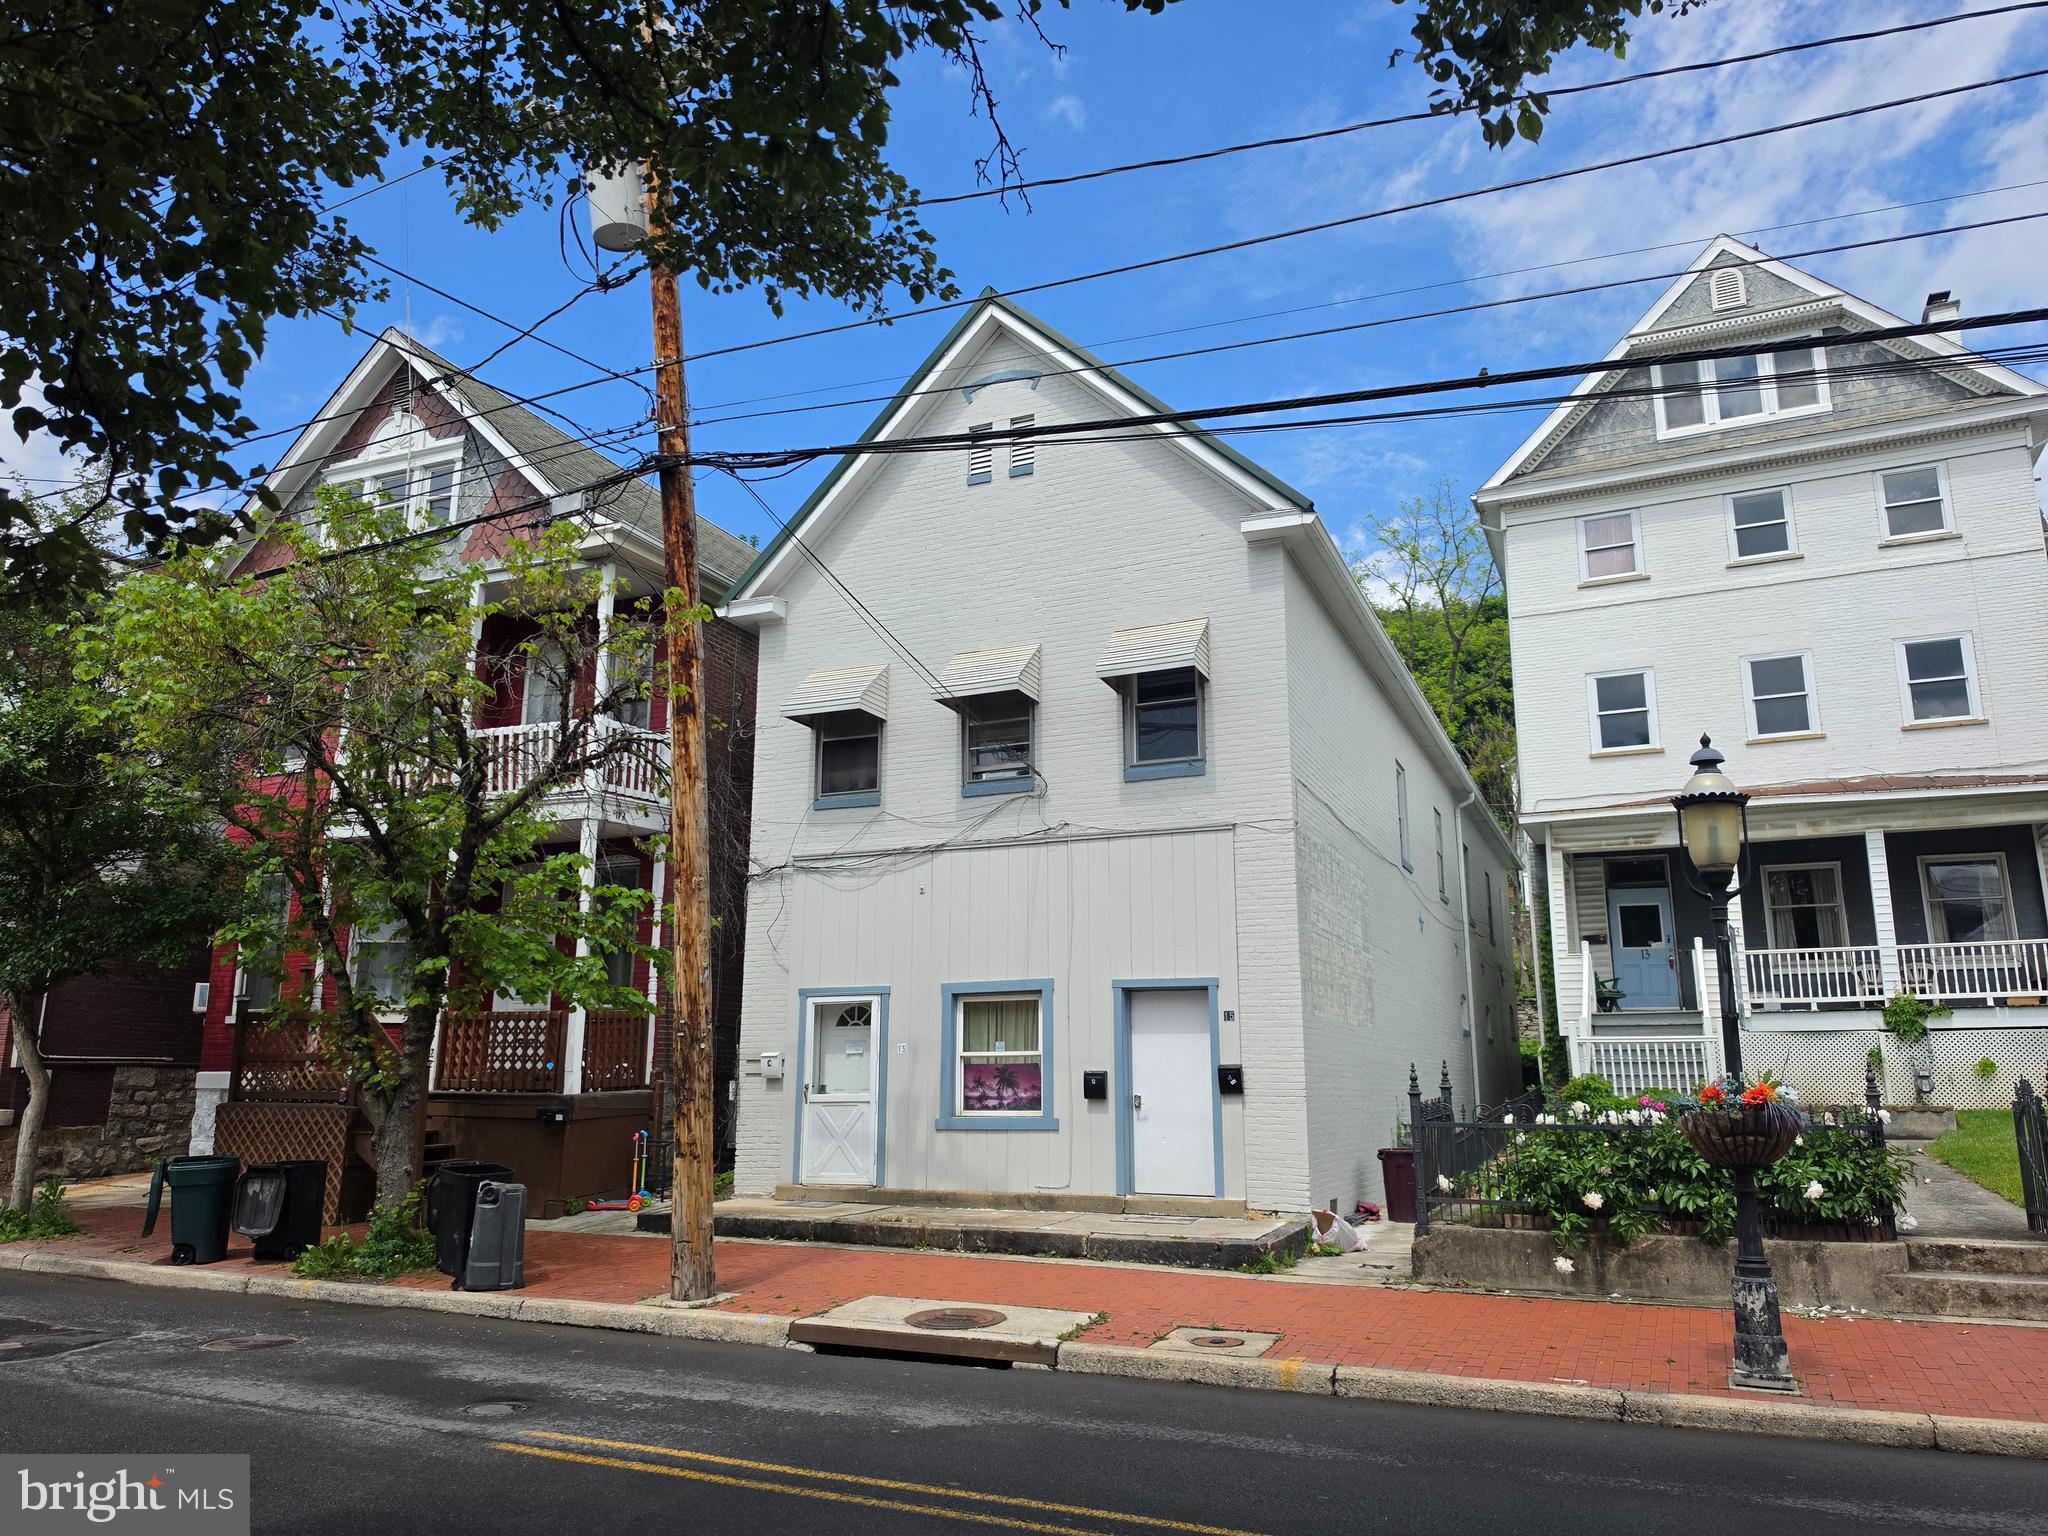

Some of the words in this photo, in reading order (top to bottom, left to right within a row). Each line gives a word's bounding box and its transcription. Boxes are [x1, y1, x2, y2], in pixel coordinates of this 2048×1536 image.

[1641, 949, 1651, 960] 13
[1224, 1011, 1235, 1021] 15
[898, 1044, 906, 1054] 15
[767, 1059, 772, 1067] C
